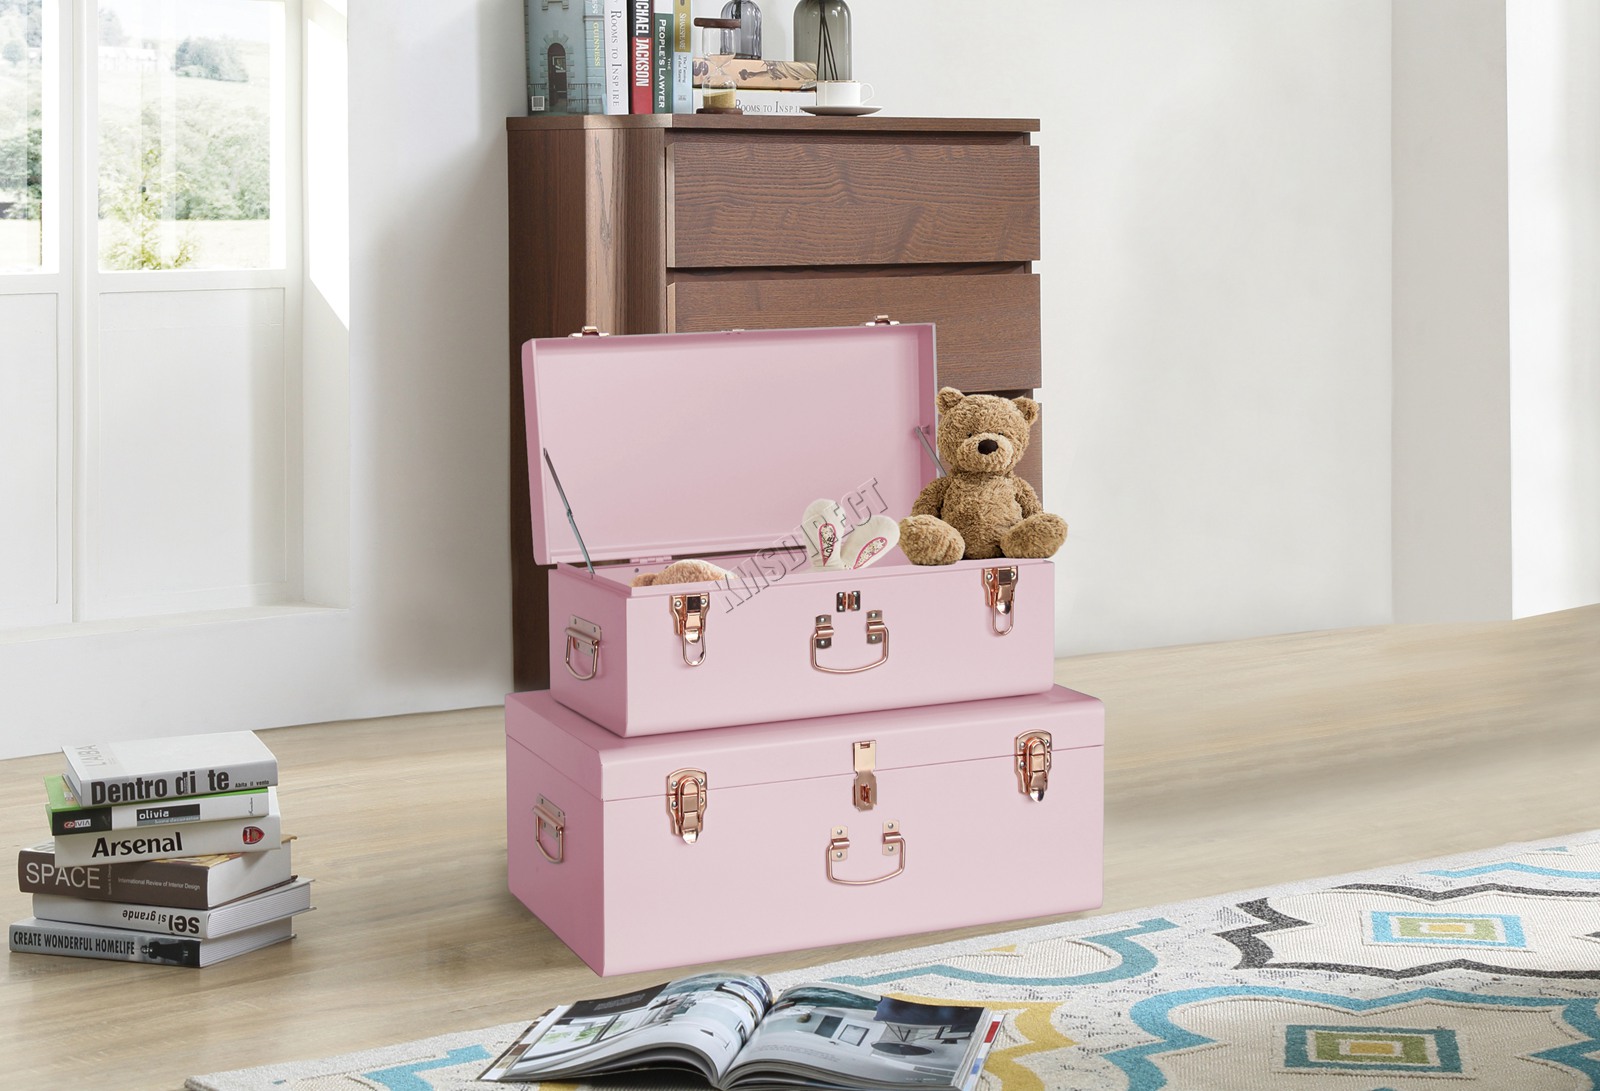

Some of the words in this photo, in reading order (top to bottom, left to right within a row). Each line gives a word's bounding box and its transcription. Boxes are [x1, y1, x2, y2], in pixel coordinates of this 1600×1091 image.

[593, 22, 601, 67] GUINNESS
[658, 19, 667, 66] PEOPLE'S
[635, 38, 649, 87] JACKSON
[658, 68, 666, 108] LAWYER
[90, 777, 168, 805] Dentro
[175, 771, 196, 796] di
[208, 769, 230, 791] te
[139, 810, 169, 820] olivia
[91, 831, 183, 858] Arsenal
[26, 862, 101, 890] SPACE
[118, 877, 146, 886] International
[145, 879, 162, 887] Review
[168, 881, 184, 889] Interior
[184, 882, 201, 891] Design
[122, 909, 157, 921] grande
[157, 914, 167, 925] si
[13, 931, 42, 946] CREATE
[44, 933, 93, 951] WONDERFUL
[95, 938, 135, 955] HOMELIFE
